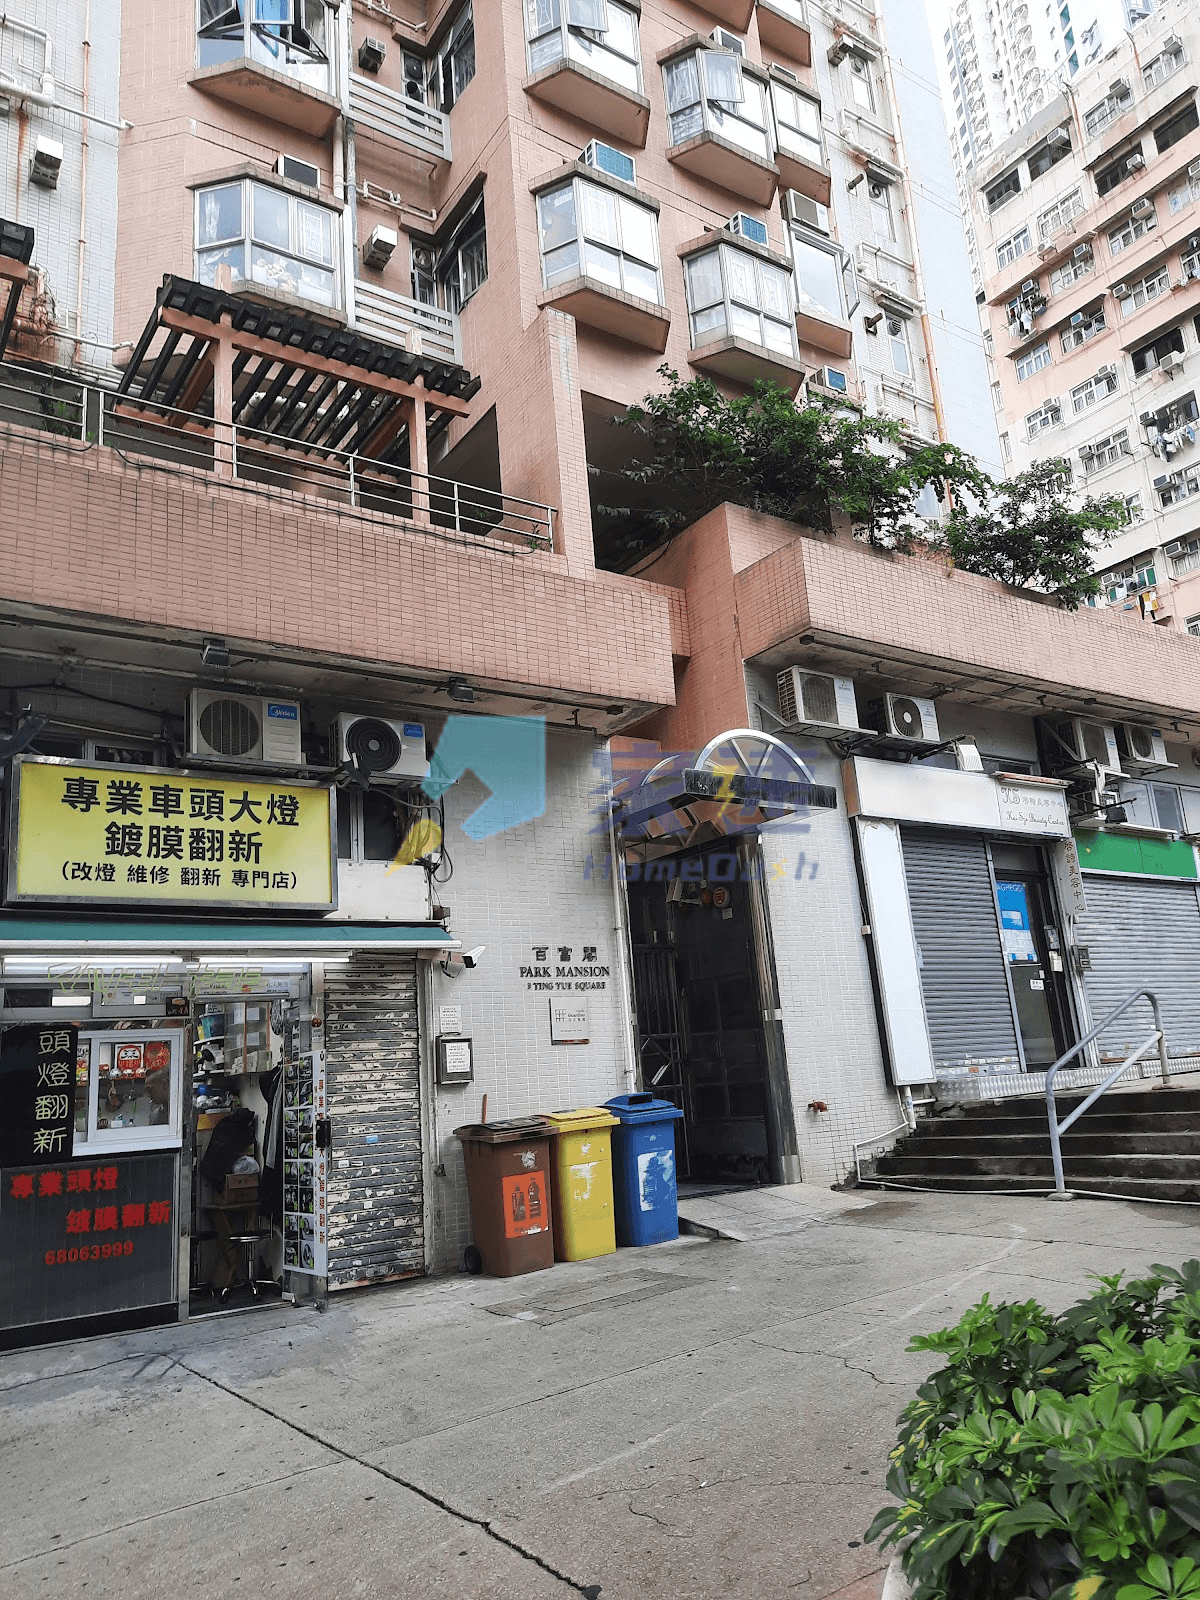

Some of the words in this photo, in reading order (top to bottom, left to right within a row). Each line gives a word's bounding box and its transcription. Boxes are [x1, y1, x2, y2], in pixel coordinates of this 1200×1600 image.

[61, 776, 300, 827] 專業車頭大燈
[104, 822, 263, 864] 鍍膜翻新
[126, 864, 170, 885] 維修
[180, 867, 221, 887] 翻新
[519, 966, 552, 977] PARK
[555, 966, 610, 977] MANSION
[532, 982, 554, 991] TING
[555, 982, 572, 990] YUE
[574, 981, 606, 991] SQUARE
[33, 1029, 72, 1154] 頭燈翻新
[10, 1166, 119, 1199] 專業頭燈
[66, 1200, 172, 1234] 鍍膜翻新
[45, 1240, 134, 1266] 68063999
